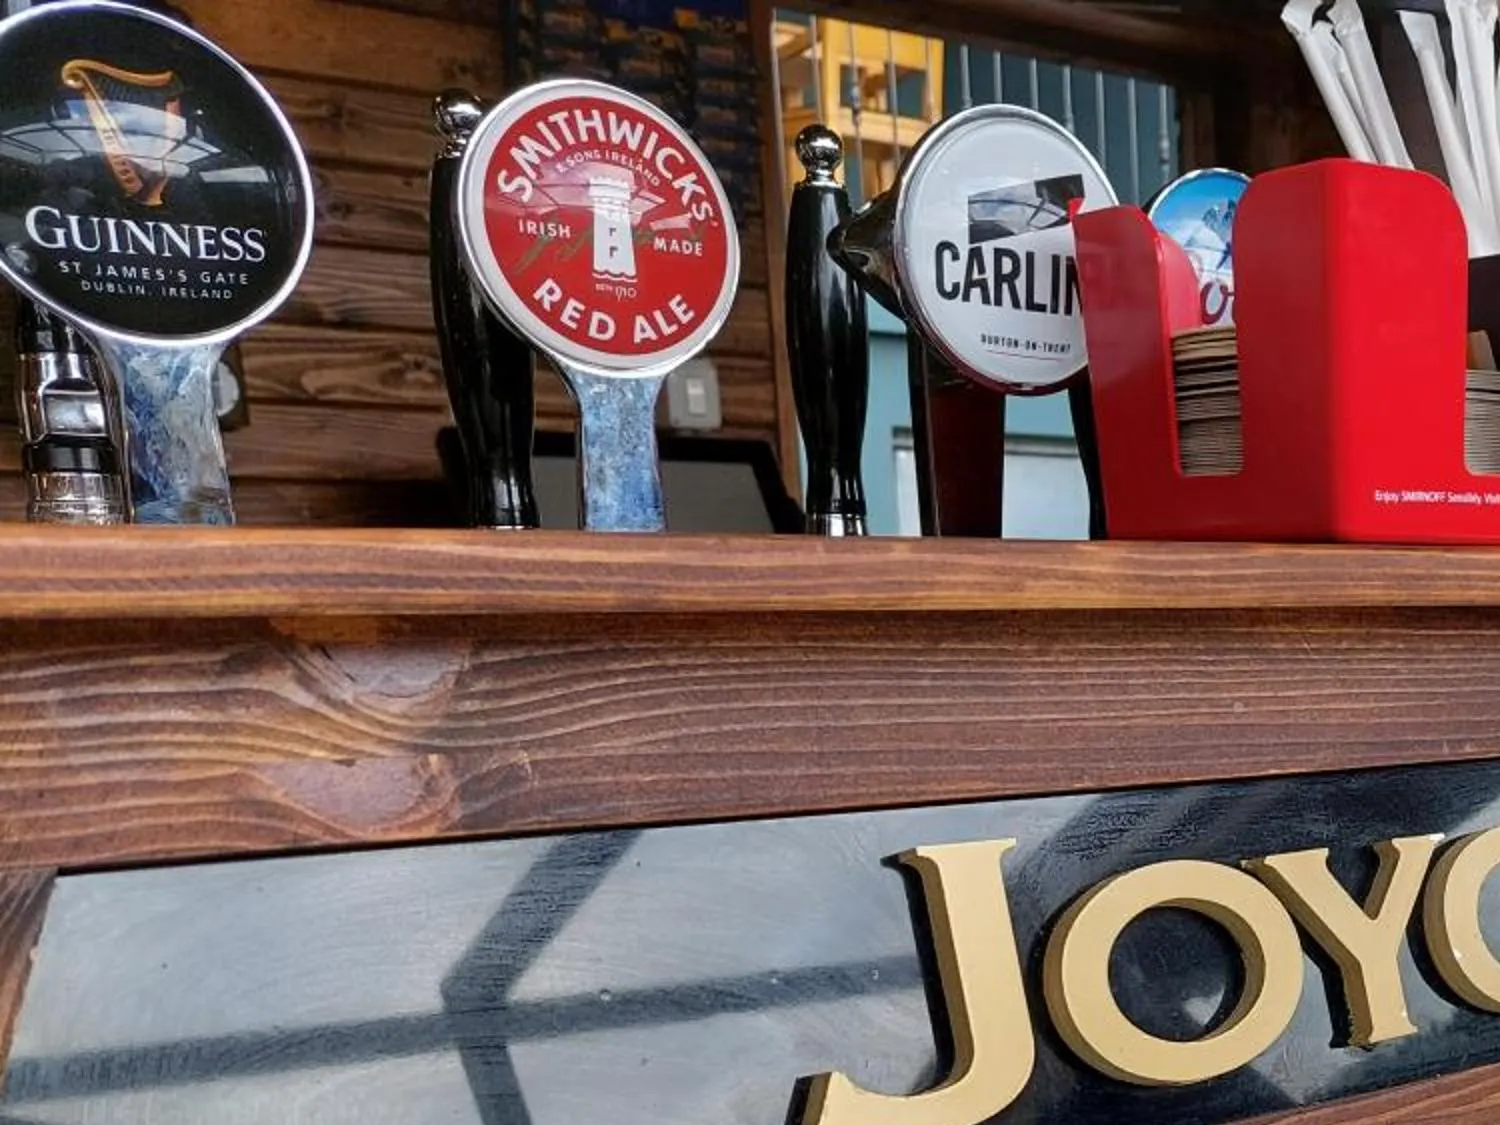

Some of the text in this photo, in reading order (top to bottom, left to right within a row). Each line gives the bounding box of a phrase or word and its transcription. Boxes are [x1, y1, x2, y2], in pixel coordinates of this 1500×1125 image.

[605, 149, 660, 187] IRELAND
[25, 204, 266, 263] GUINNESS
[518, 218, 703, 257] IRISH MADE
[58, 260, 250, 286] ST JAMES'S GATE
[934, 239, 1084, 317] CARLIN
[161, 286, 233, 300] IRELAND
[533, 277, 696, 345] RED ALE
[1375, 489, 1399, 505] Enjoy
[1400, 490, 1446, 504] SMIRNOFF
